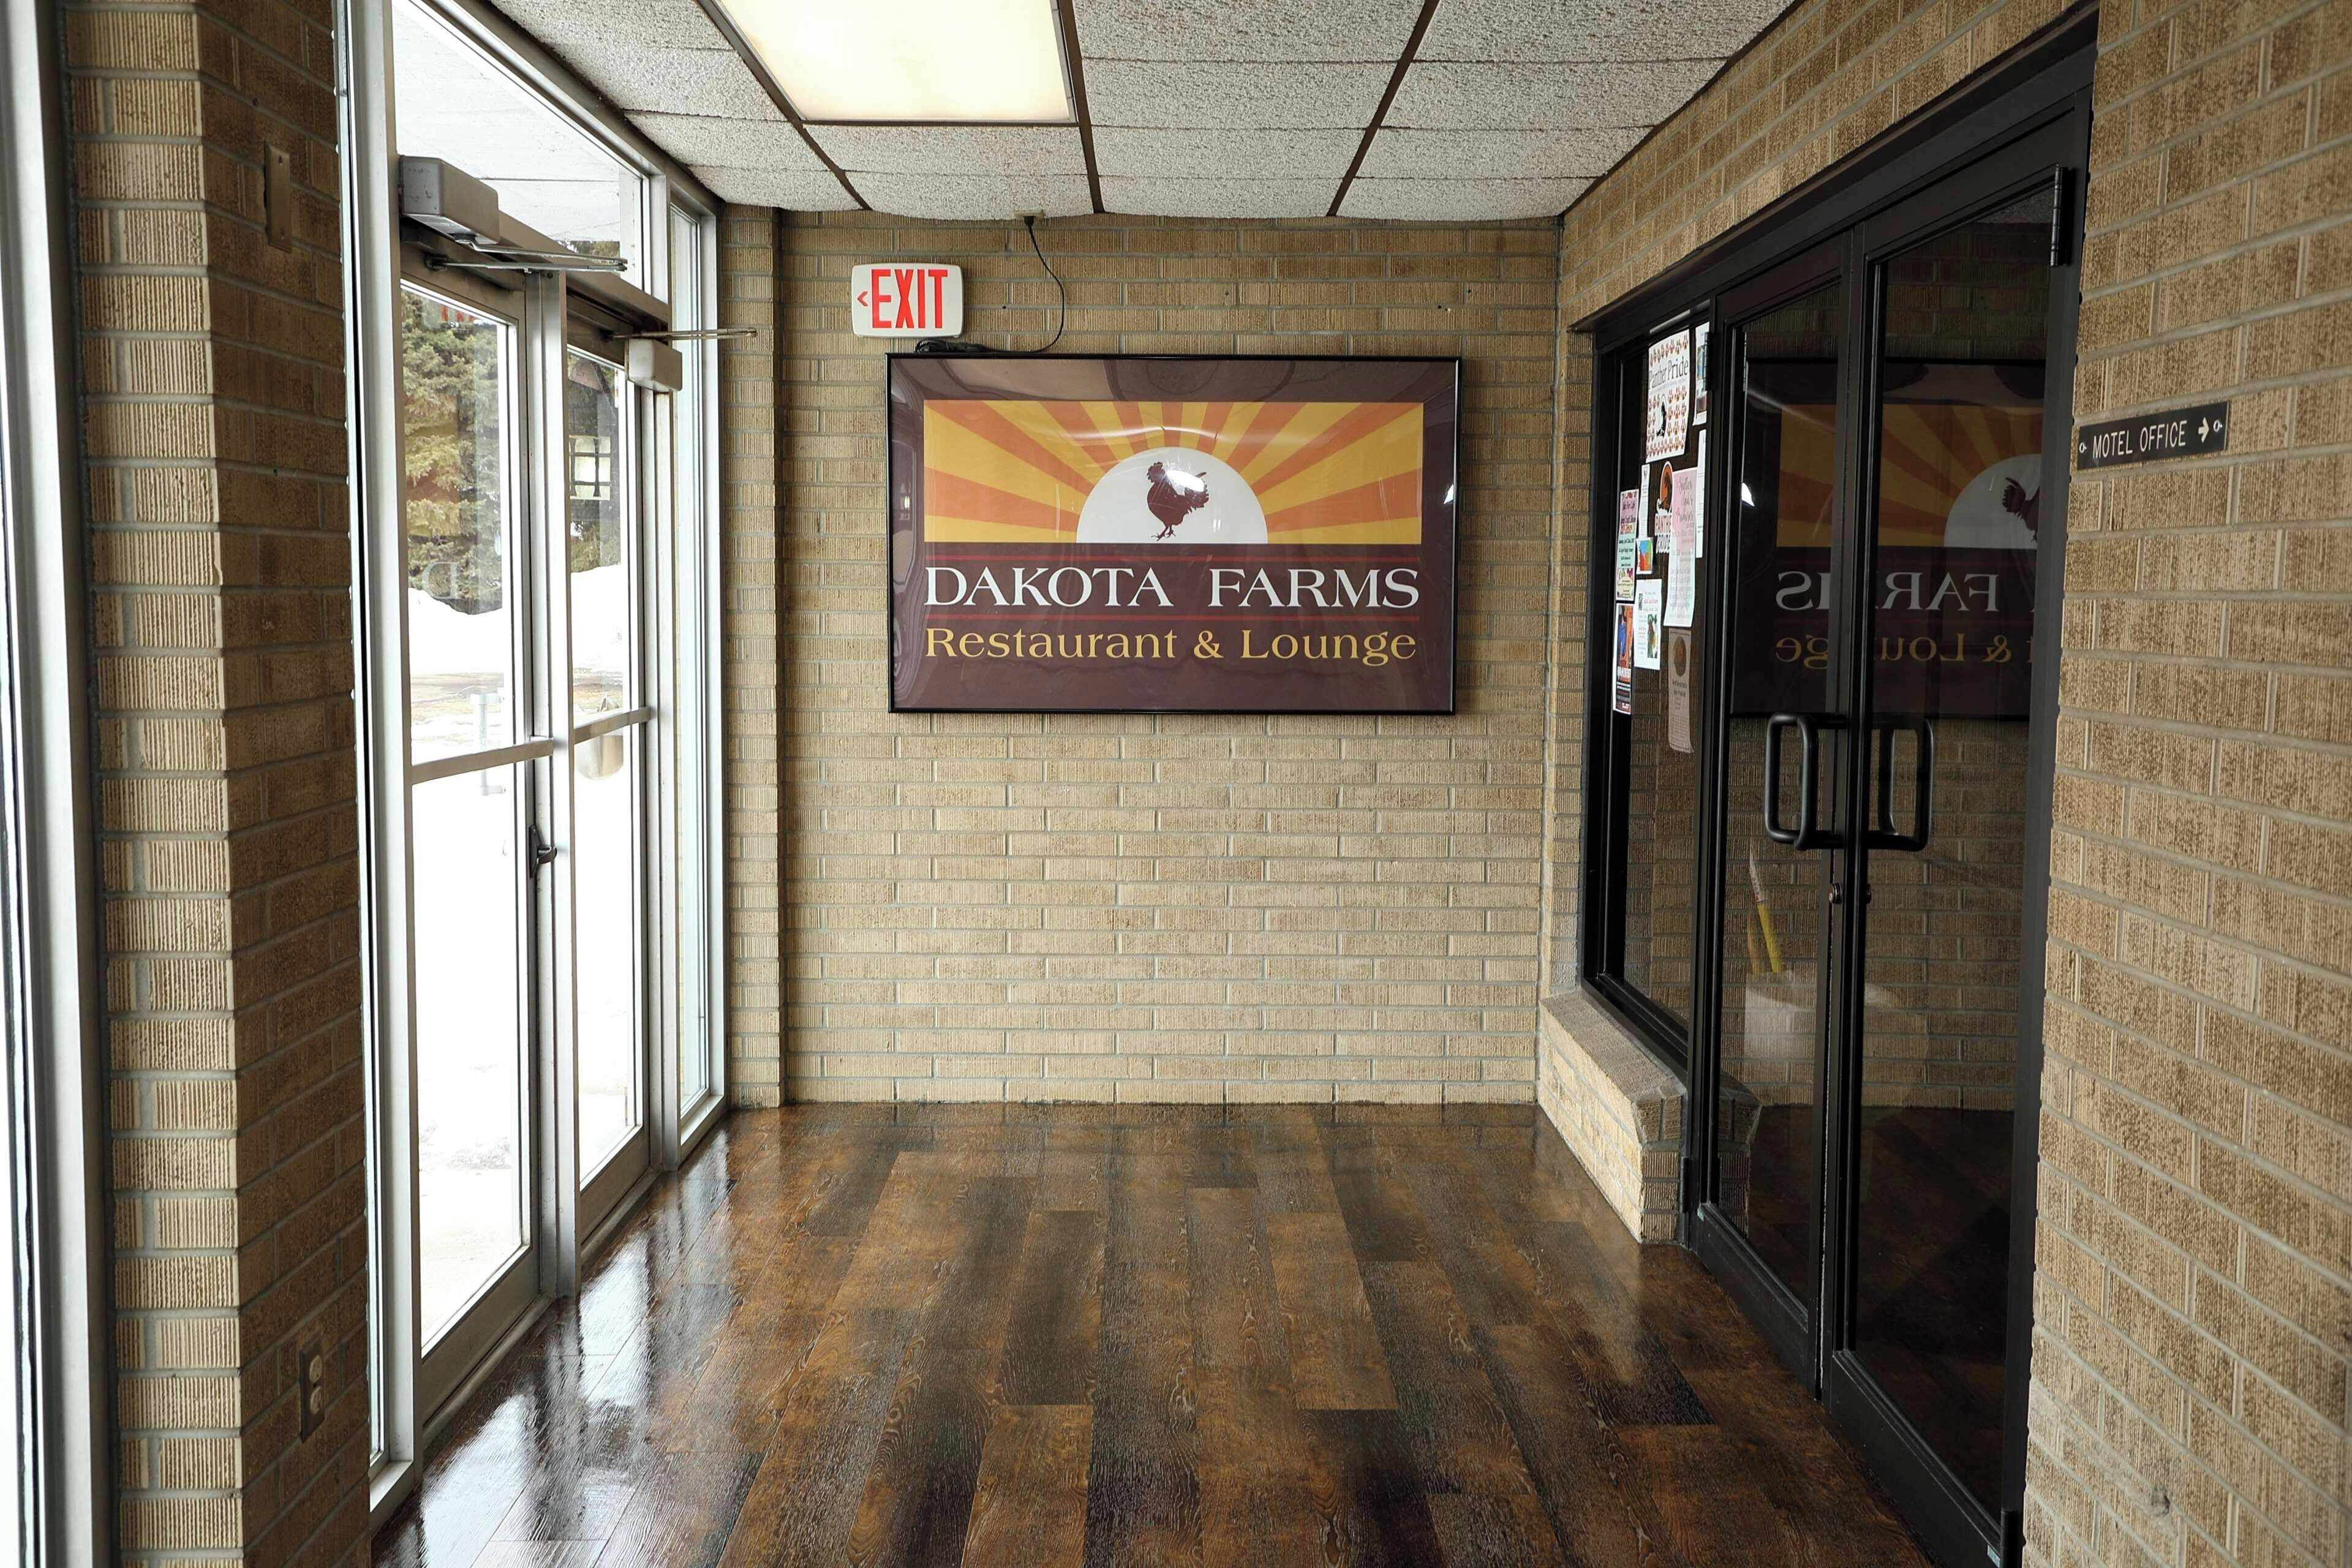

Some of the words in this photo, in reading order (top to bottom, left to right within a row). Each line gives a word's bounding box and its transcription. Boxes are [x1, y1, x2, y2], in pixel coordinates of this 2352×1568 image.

[872, 269, 948, 329] EXIT
[1648, 365, 1667, 389] Panther
[1668, 355, 1689, 381] Pride
[2092, 429, 2133, 459] MOTEL
[2139, 420, 2187, 453] OFFICE
[924, 566, 1174, 607] DAKOTA
[1208, 567, 1420, 608] FARMS
[925, 627, 1177, 658] Restaurant
[1193, 630, 1224, 659] &
[1240, 629, 1416, 667] Lounge
